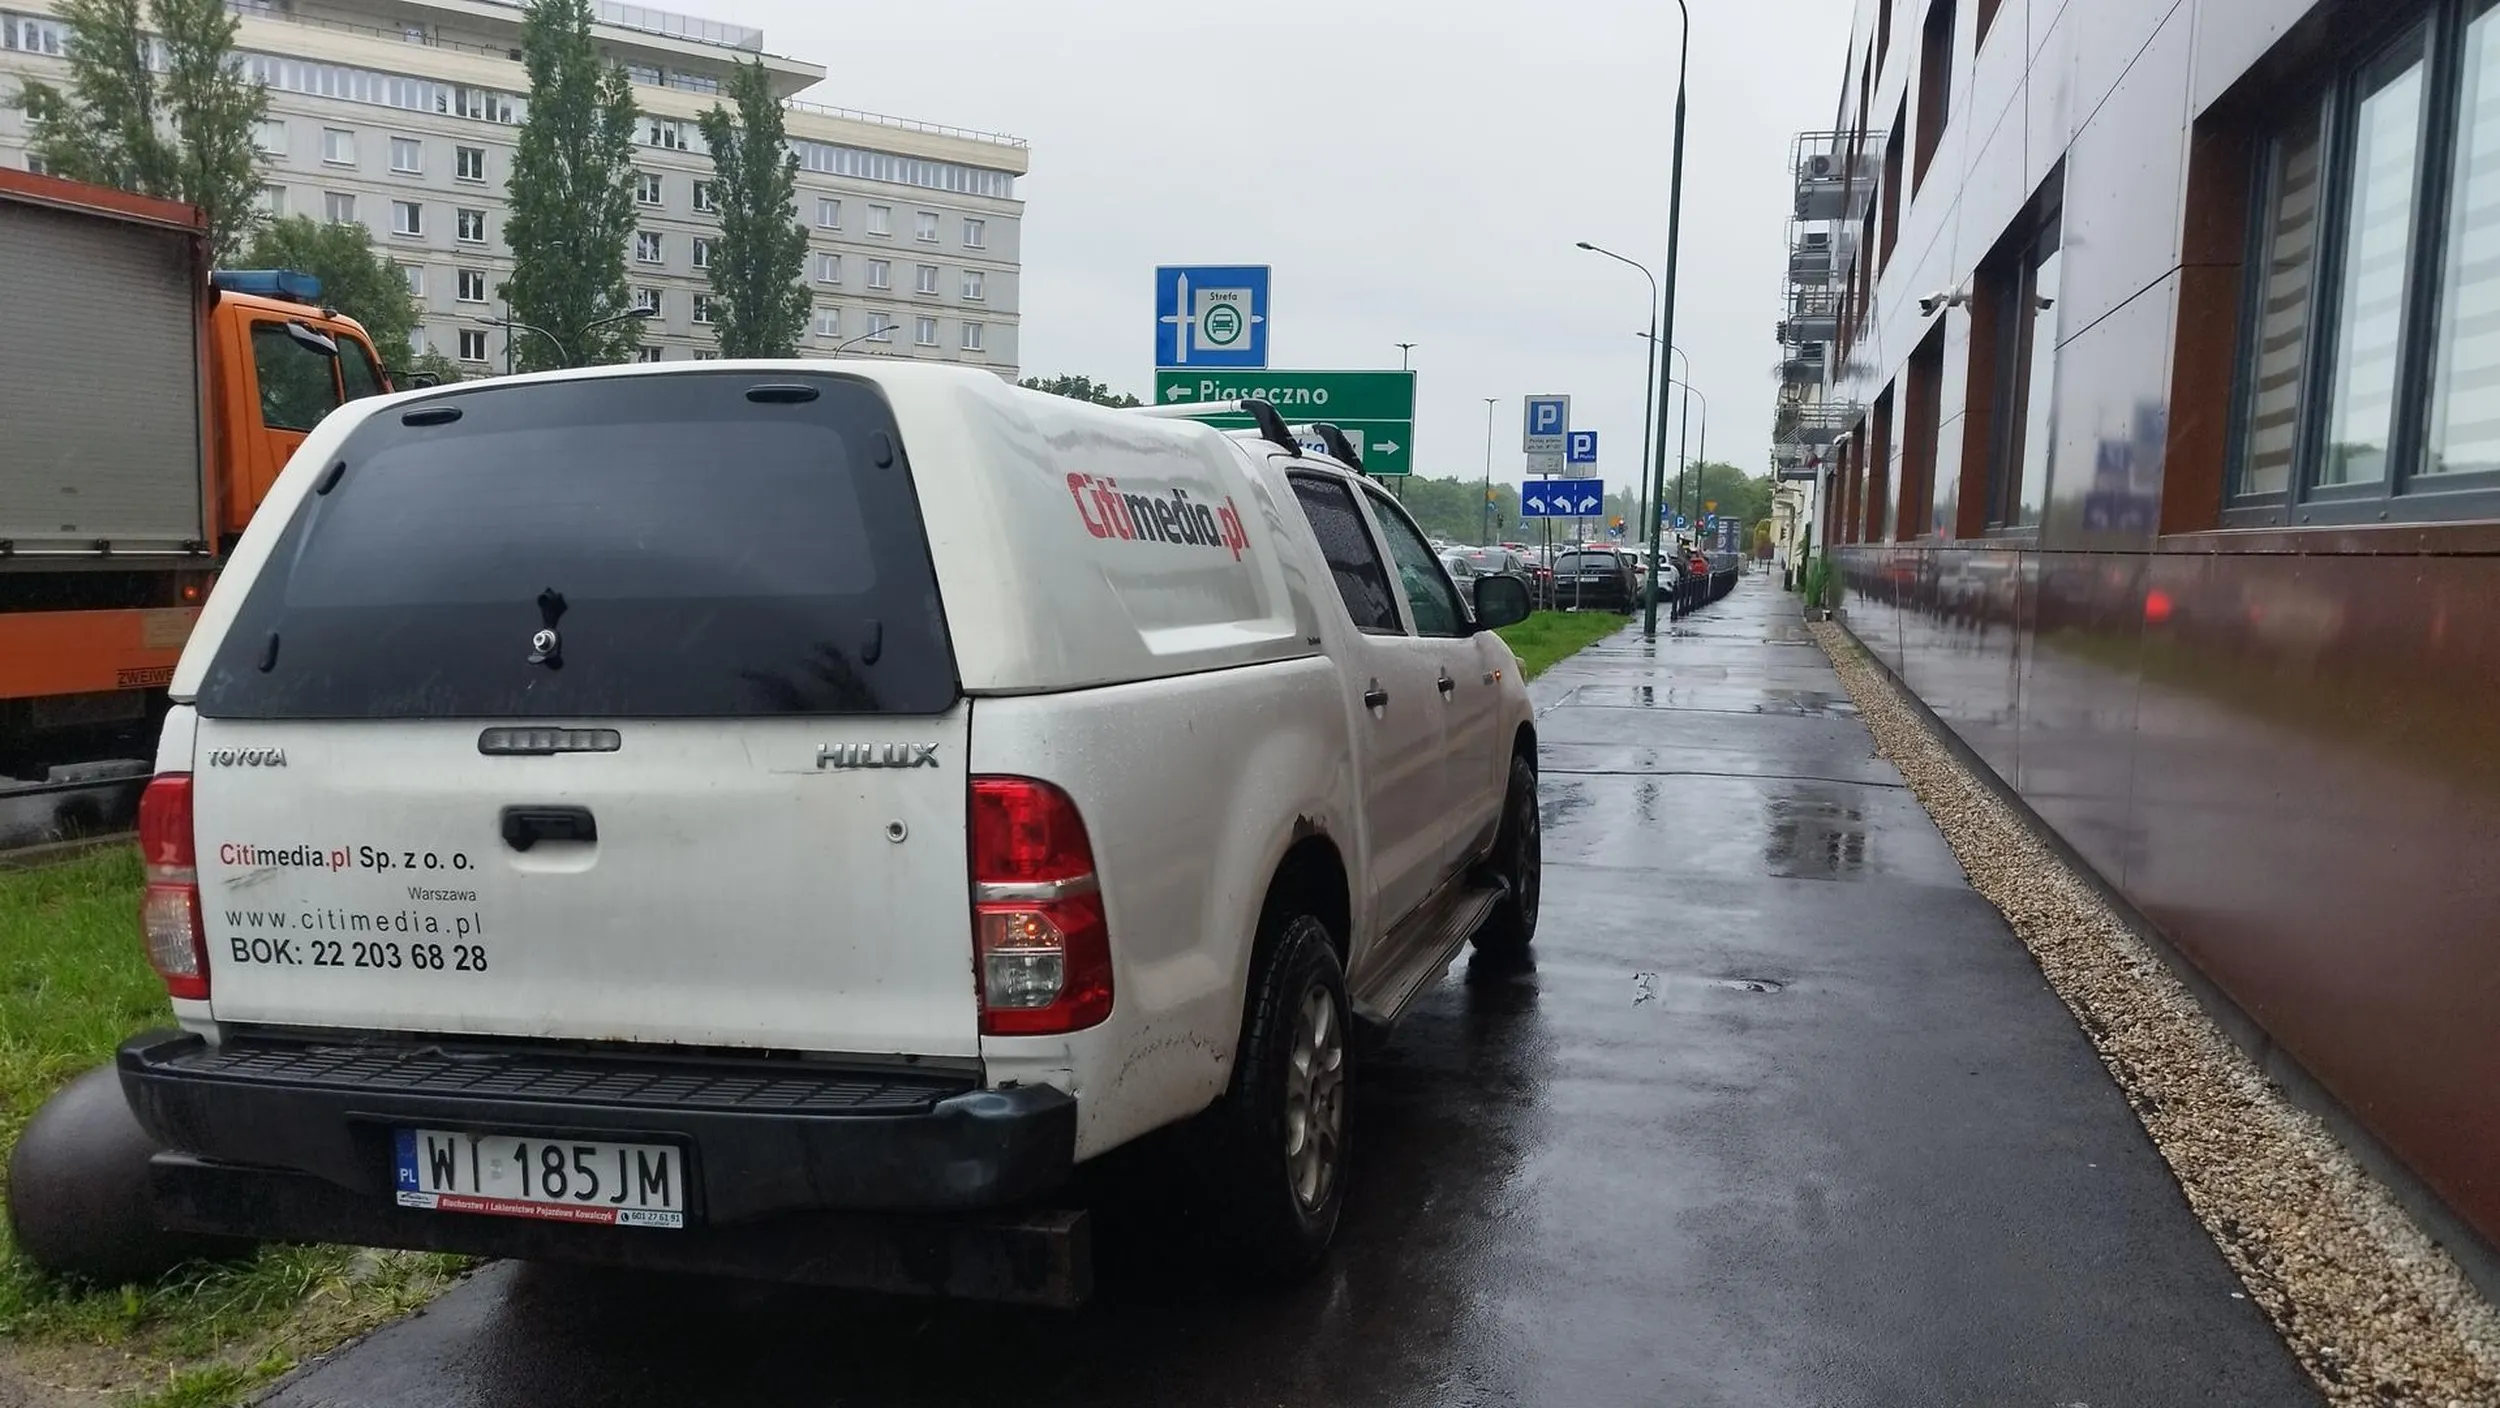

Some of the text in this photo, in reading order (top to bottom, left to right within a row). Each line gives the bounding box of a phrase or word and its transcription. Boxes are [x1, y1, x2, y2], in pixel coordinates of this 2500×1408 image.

[1210, 291, 1238, 301] Strefa
[1200, 380, 1329, 405] Piaseczno
[1538, 404, 1557, 431] P
[1573, 434, 1591, 460] P
[1066, 471, 1251, 563] Citimedia.pl
[208, 747, 287, 767] TOYOTA
[816, 742, 940, 768] HILUX
[220, 843, 475, 874] Citimedia.pl Sp. z o. o.
[407, 886, 477, 901] Warszawa
[225, 908, 481, 939] www.citimedia.pl
[230, 937, 488, 972] BOK: 22 203 68 28
[400, 1168, 416, 1183] PL
[513, 1142, 671, 1207] 185JM
[631, 1211, 646, 1220] 601
[648, 1212, 658, 1221] 27
[670, 1214, 680, 1222] 91
